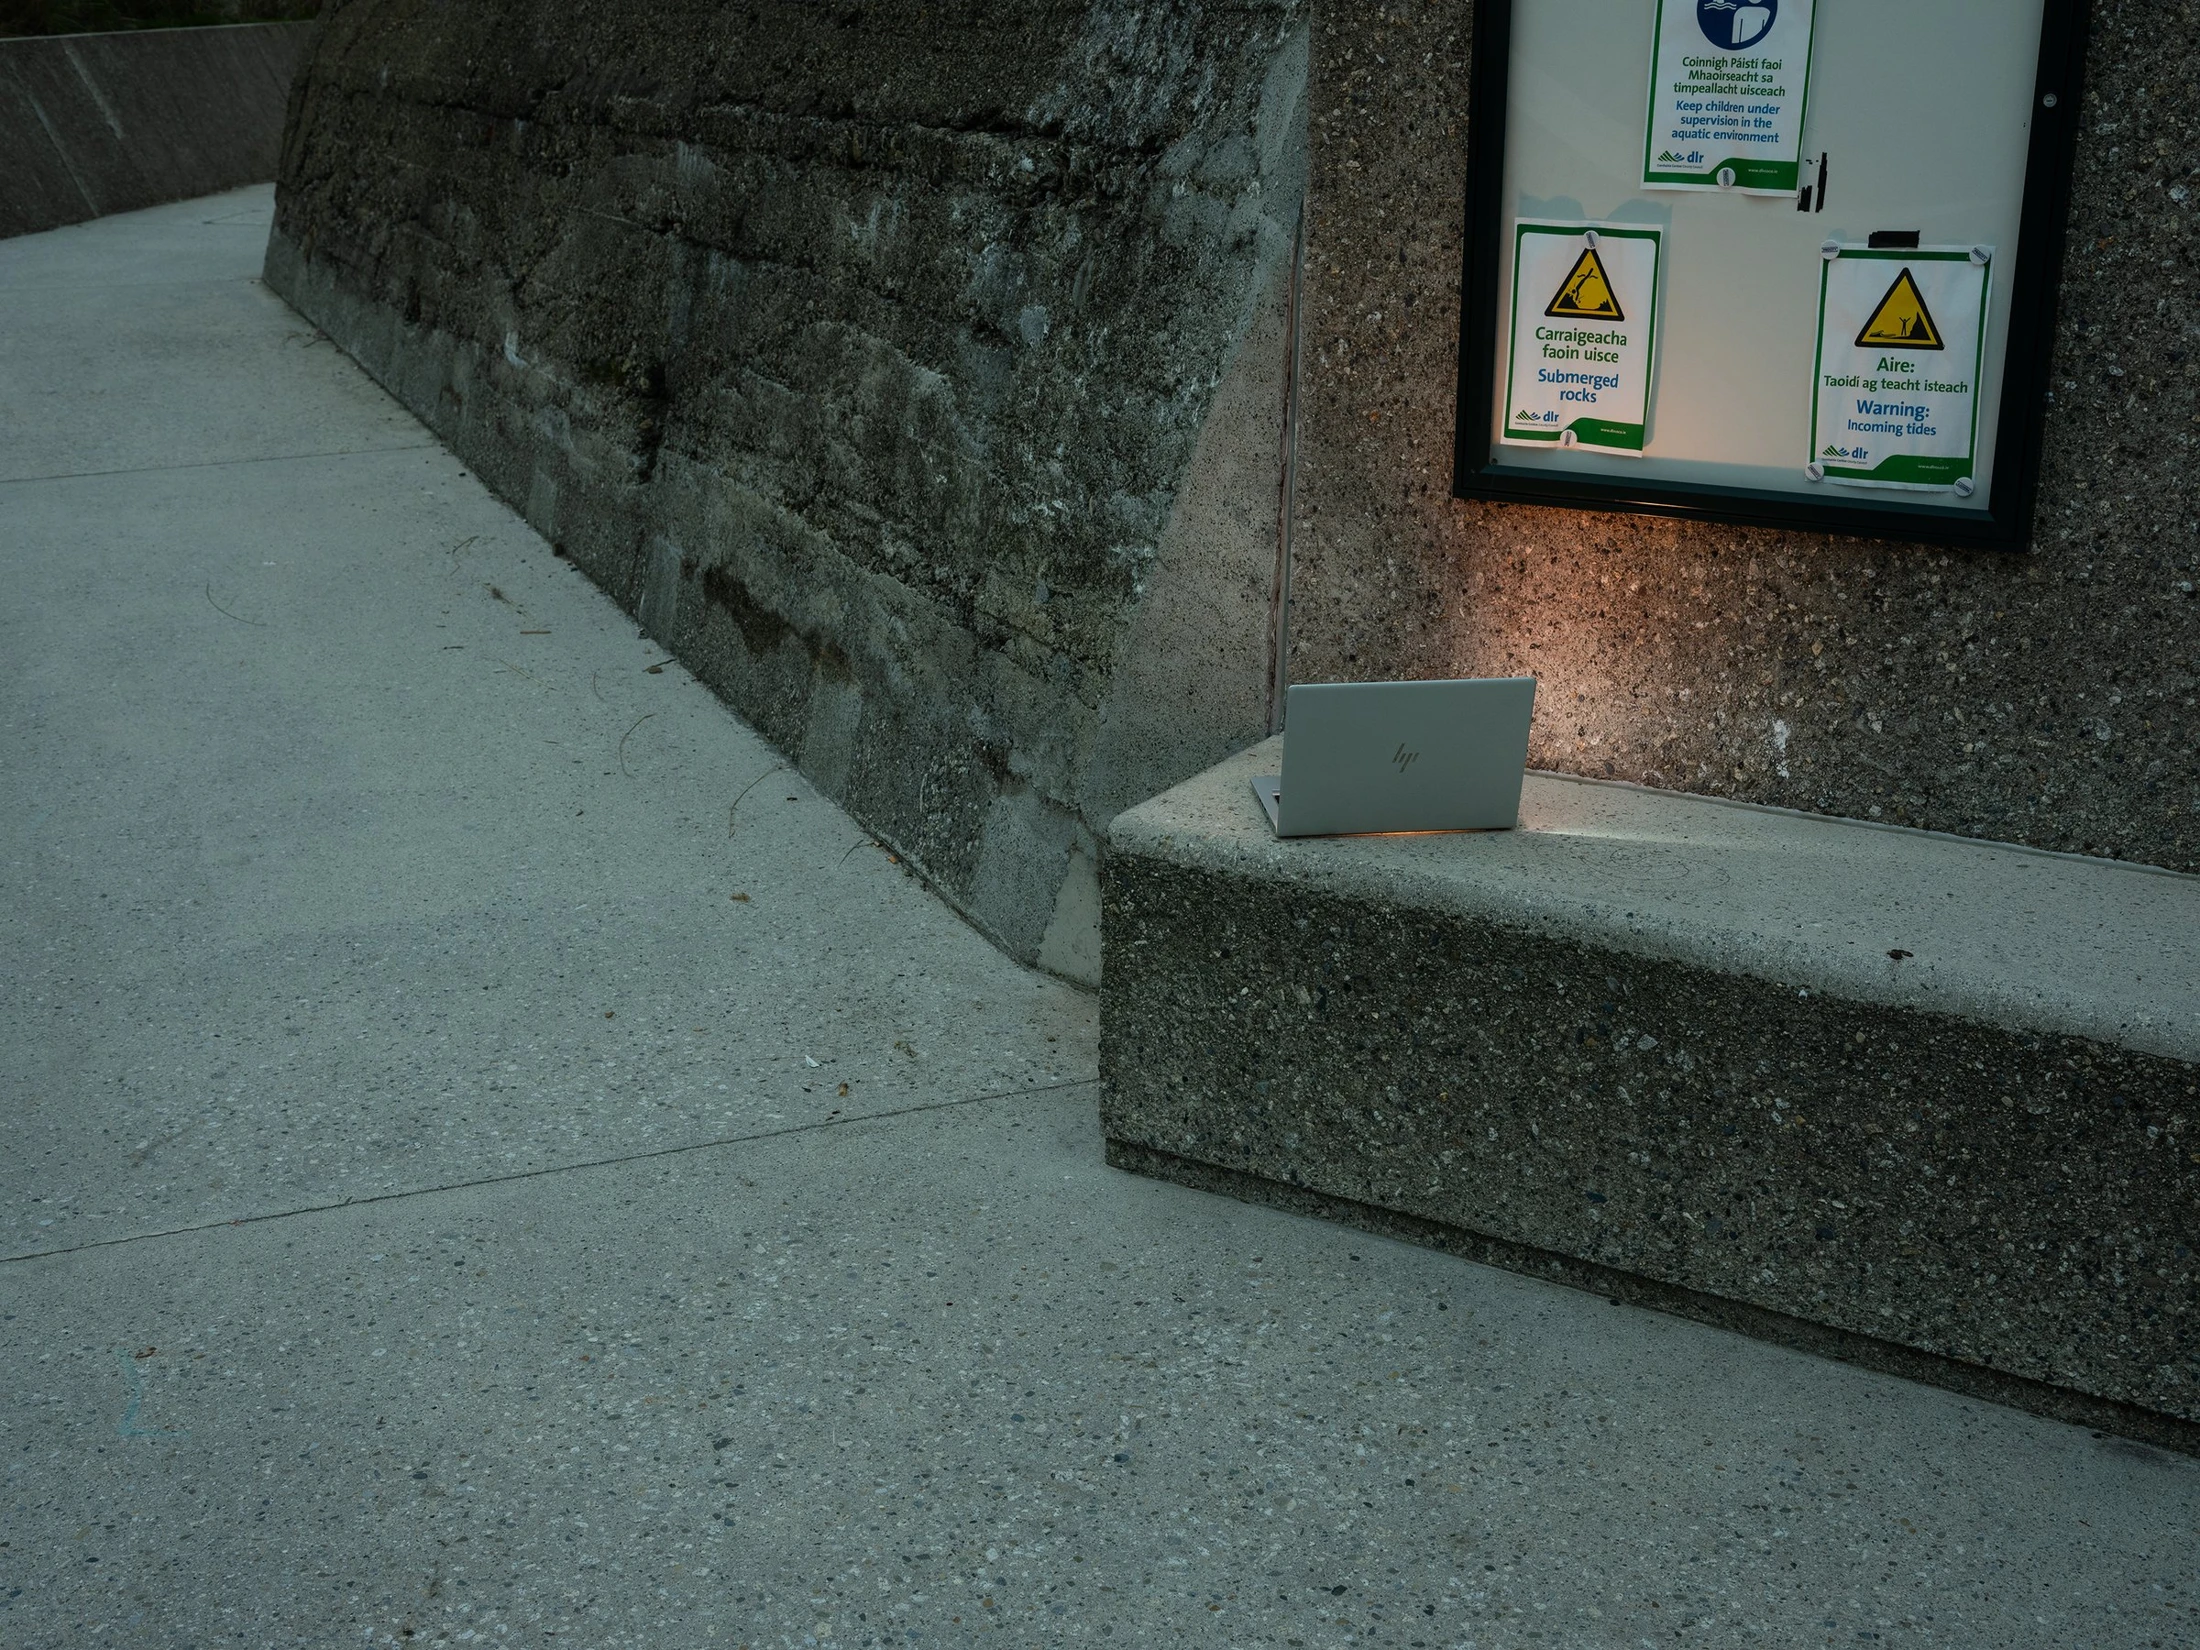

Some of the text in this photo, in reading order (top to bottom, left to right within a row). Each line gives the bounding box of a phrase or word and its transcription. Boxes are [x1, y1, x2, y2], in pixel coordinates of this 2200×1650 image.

[1682, 56, 1782, 70] Coinnigh Páistí faoi
[1688, 70, 1773, 83] Mhaoirseacht sa
[1673, 83, 1785, 97] timpeallacht uisceach
[1676, 100, 1780, 115] Keep children under
[1680, 115, 1772, 129] supervision in the
[1671, 129, 1779, 143] aquatic environment
[1687, 151, 1704, 163] dlr
[1535, 326, 1627, 347] Carraigeacha
[1542, 344, 1619, 363] faoin uisce
[1876, 357, 1915, 373] Aire:
[1538, 368, 1619, 390] Submerged
[1824, 375, 1968, 393] Taoidí ag teacht isteach
[1559, 388, 1597, 403] rocks
[1543, 410, 1559, 422] dlr
[1856, 399, 1930, 422] Warning:
[1847, 419, 1937, 437] Incoming tides
[1851, 446, 1868, 459] dlr
